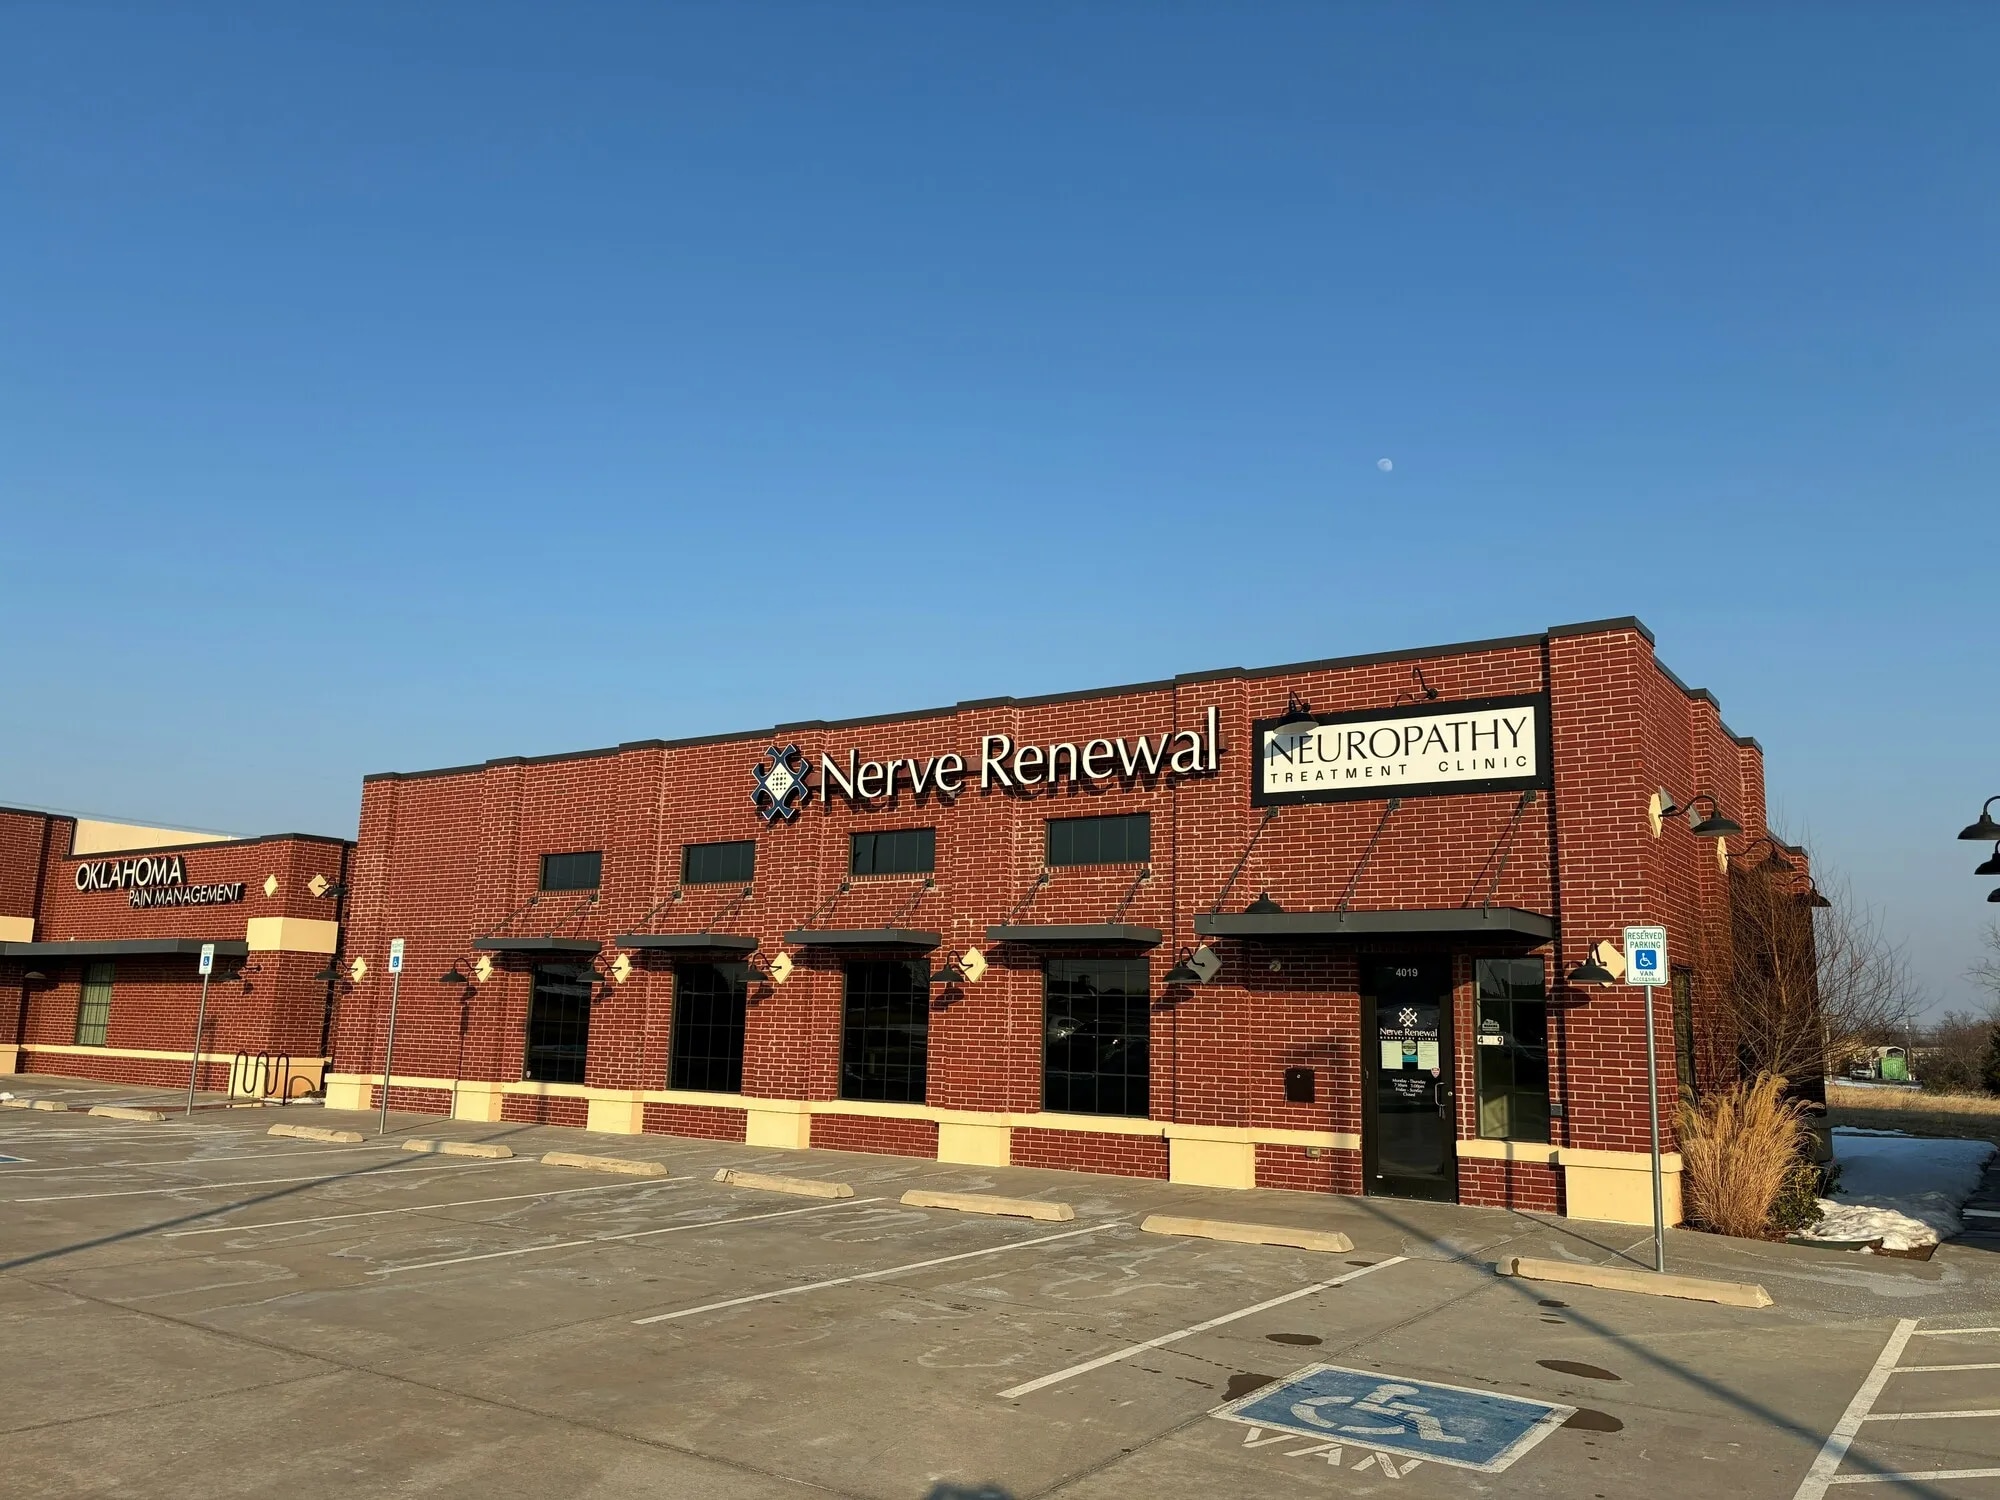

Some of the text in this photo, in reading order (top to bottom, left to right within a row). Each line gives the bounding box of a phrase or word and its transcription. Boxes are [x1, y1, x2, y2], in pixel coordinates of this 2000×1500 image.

[821, 706, 1220, 801] Nerve Renewal
[1270, 716, 1528, 767] NEUROPATHY
[1271, 755, 1528, 784] TREATMENT CLINIC
[75, 856, 182, 891] OKLAHOMA
[129, 883, 242, 907] PAIN MANAGEMENT
[1627, 931, 1663, 940] RESERVED
[1630, 941, 1661, 949] PARKING
[1395, 968, 1418, 977] 4019
[1380, 1027, 1438, 1038] Nerve Renewal
[1242, 1427, 1423, 1479] VAN
